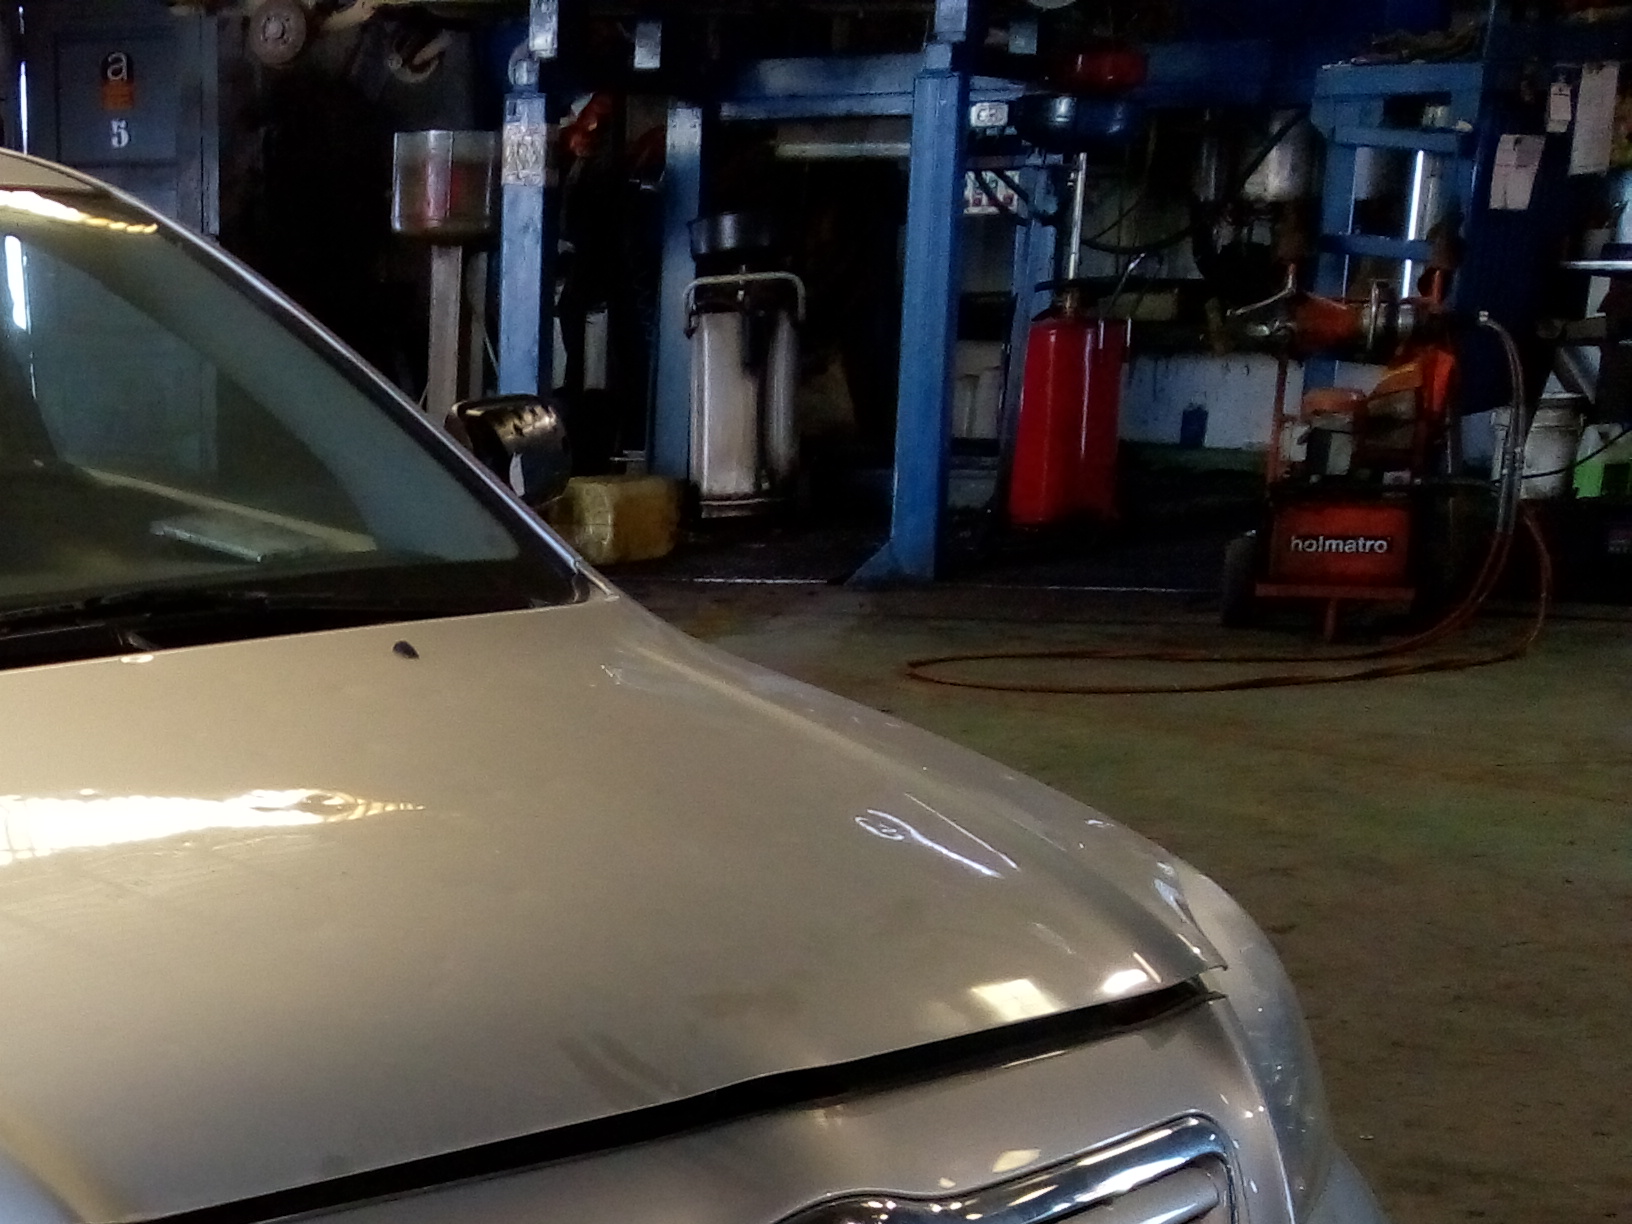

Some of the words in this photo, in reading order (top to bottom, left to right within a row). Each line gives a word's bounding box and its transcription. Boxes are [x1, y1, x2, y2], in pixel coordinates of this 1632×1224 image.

[107, 51, 128, 81] a
[110, 118, 130, 148] 5
[1290, 535, 1388, 554] holmatro
